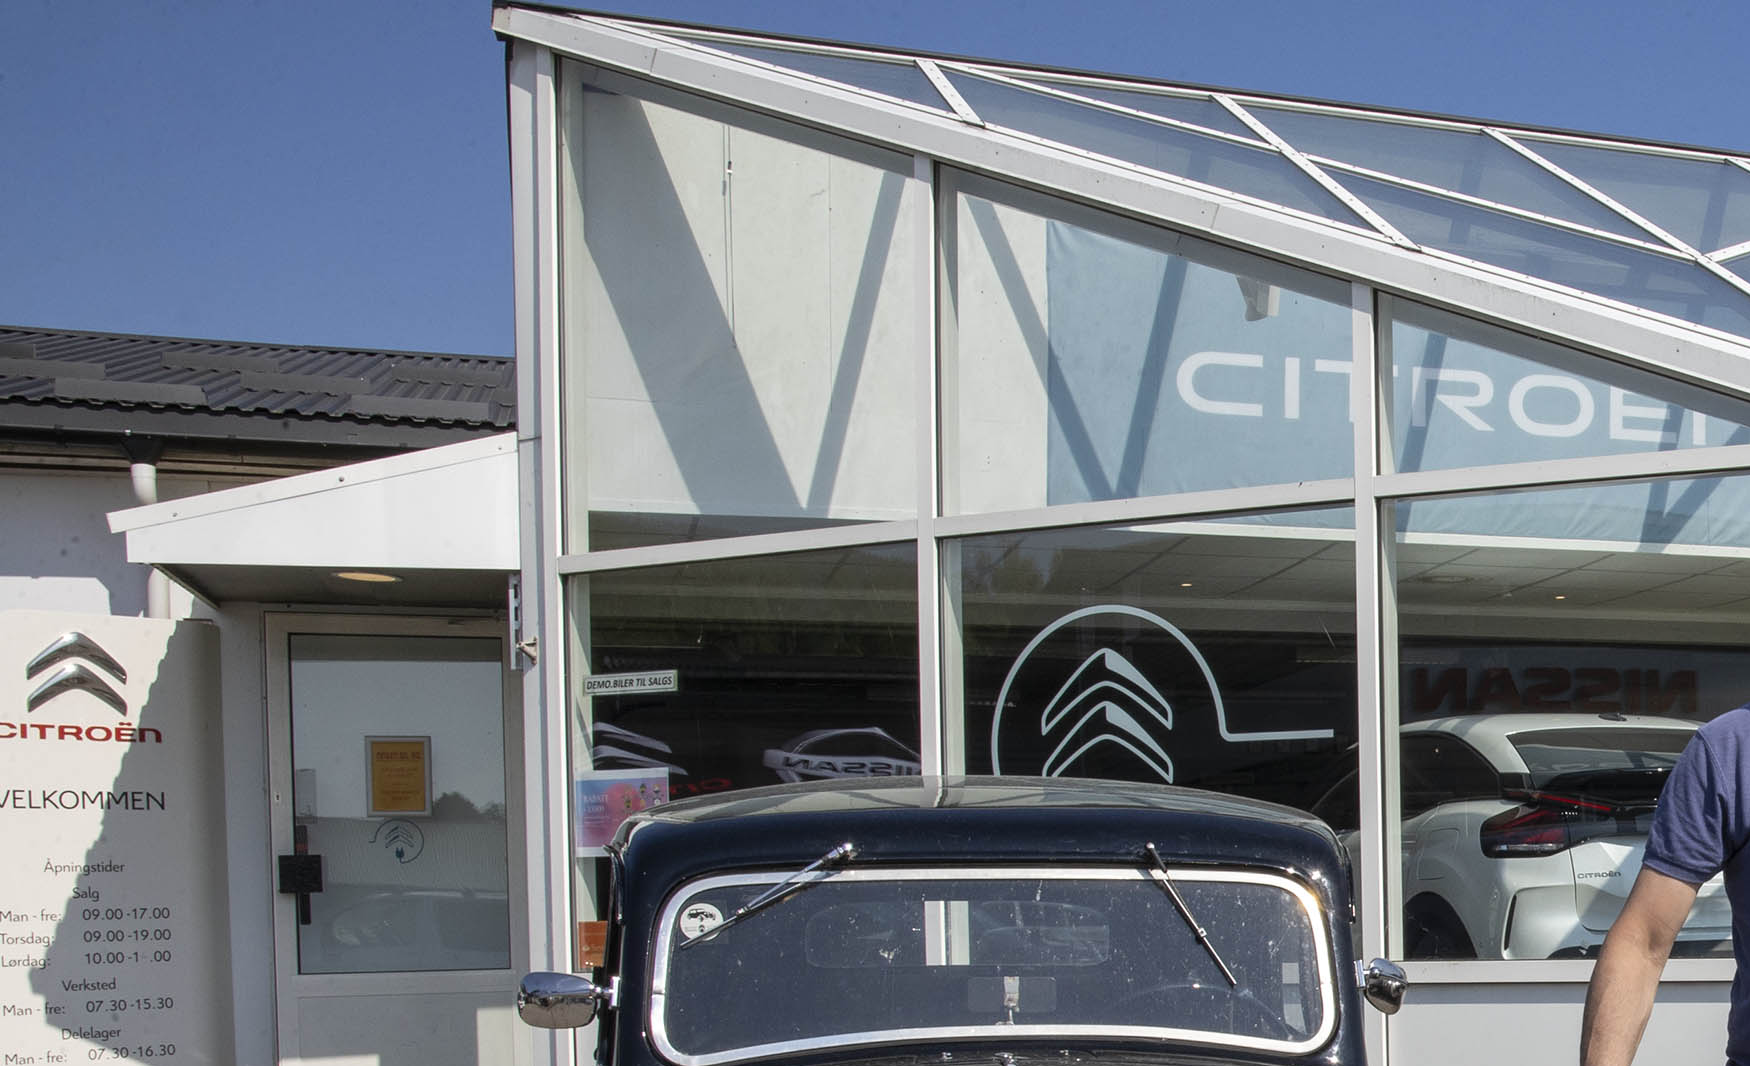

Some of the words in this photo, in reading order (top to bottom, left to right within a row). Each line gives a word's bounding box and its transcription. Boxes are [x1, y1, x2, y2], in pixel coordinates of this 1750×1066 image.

[635, 678, 647, 687] TIL
[648, 676, 673, 686] SALGS
[44, 858, 126, 876] Åpningstider
[72, 886, 100, 902] Salg
[0, 911, 28, 923] Man
[41, 909, 62, 922] fre:
[82, 908, 123, 921] 09.00
[0, 933, 55, 947] Torsdag:
[83, 930, 125, 943] 09.00
[1, 954, 51, 970] Lørdag:
[84, 952, 125, 965] 10.00
[62, 976, 117, 992] Verksted
[3, 1004, 33, 1017] Man
[45, 1002, 66, 1015] fre:
[86, 999, 127, 1013] 07.30
[62, 1026, 122, 1042] Delelager
[5, 1053, 35, 1066] Man
[46, 1051, 68, 1064] fre:
[88, 1047, 129, 1061] 07.30
